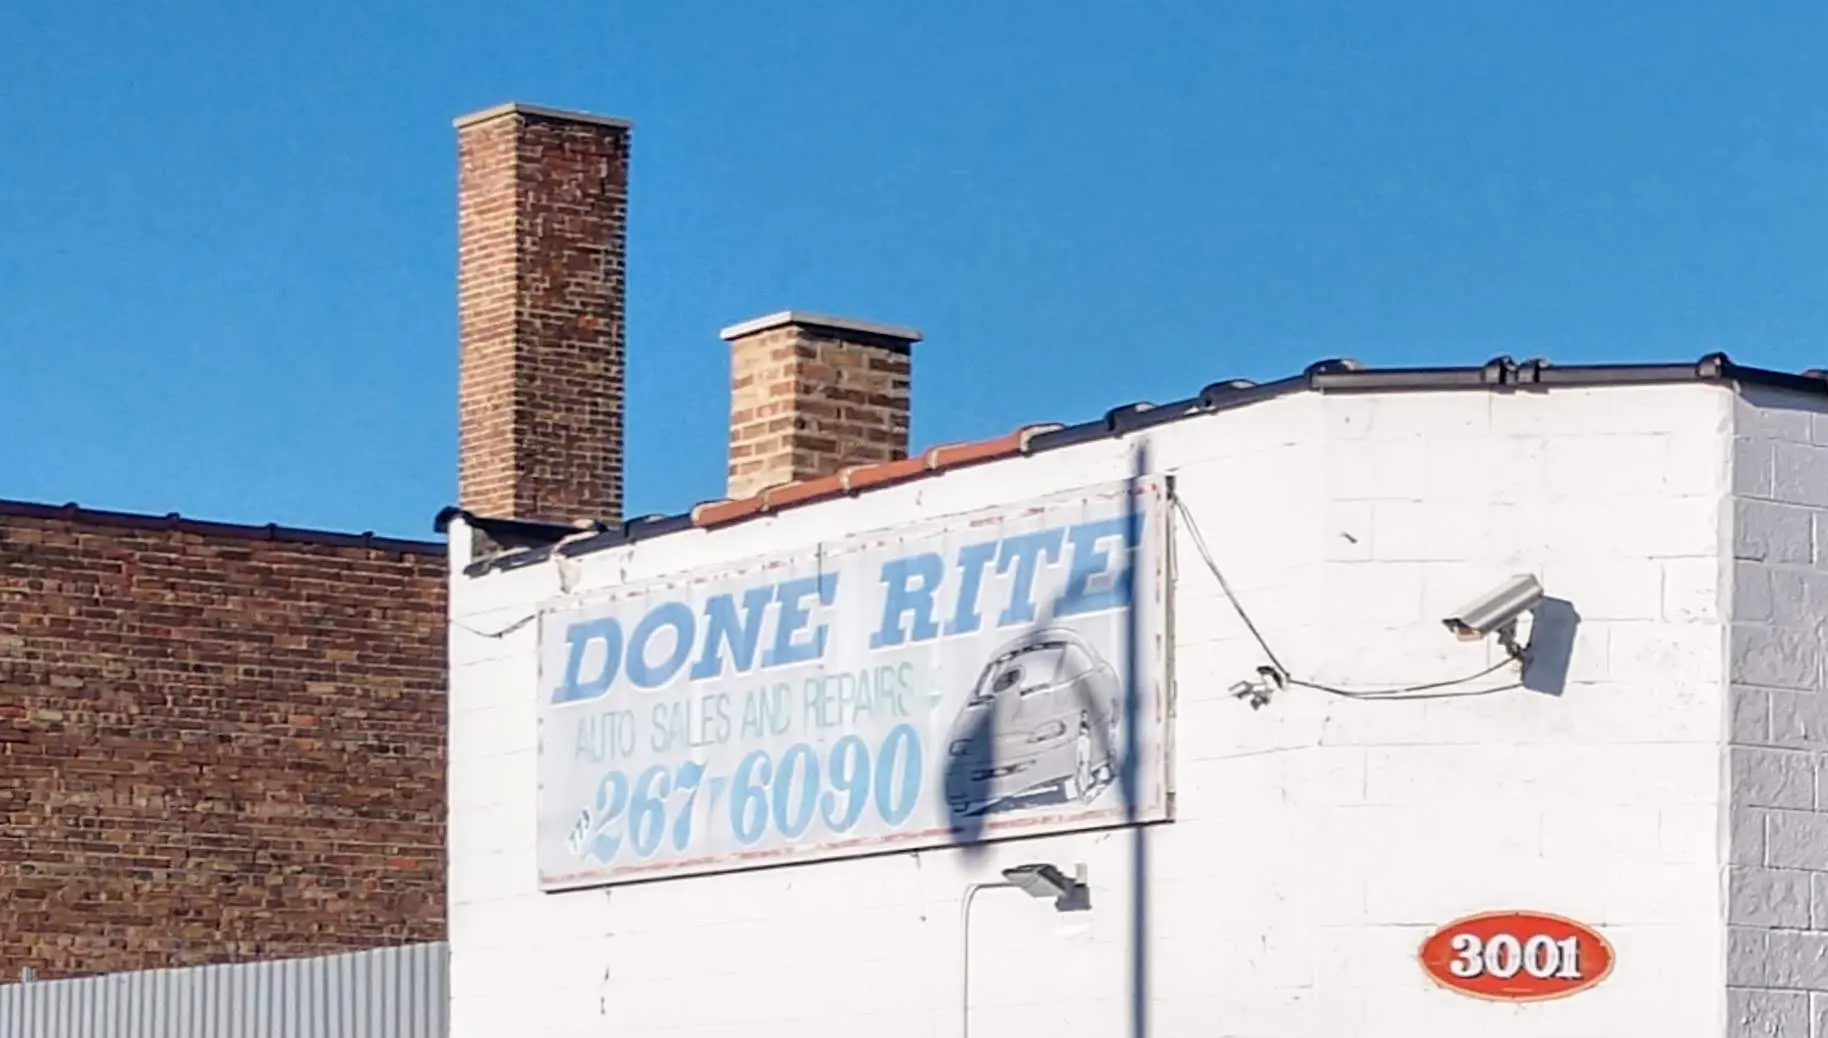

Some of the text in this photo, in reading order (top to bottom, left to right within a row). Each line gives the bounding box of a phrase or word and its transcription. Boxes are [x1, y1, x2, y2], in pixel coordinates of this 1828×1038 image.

[551, 512, 1146, 704] DONE RITE
[575, 661, 914, 763] AUTO SALES AND REPAIRS
[730, 723, 923, 845] 6090
[1450, 934, 1583, 980] 3001
